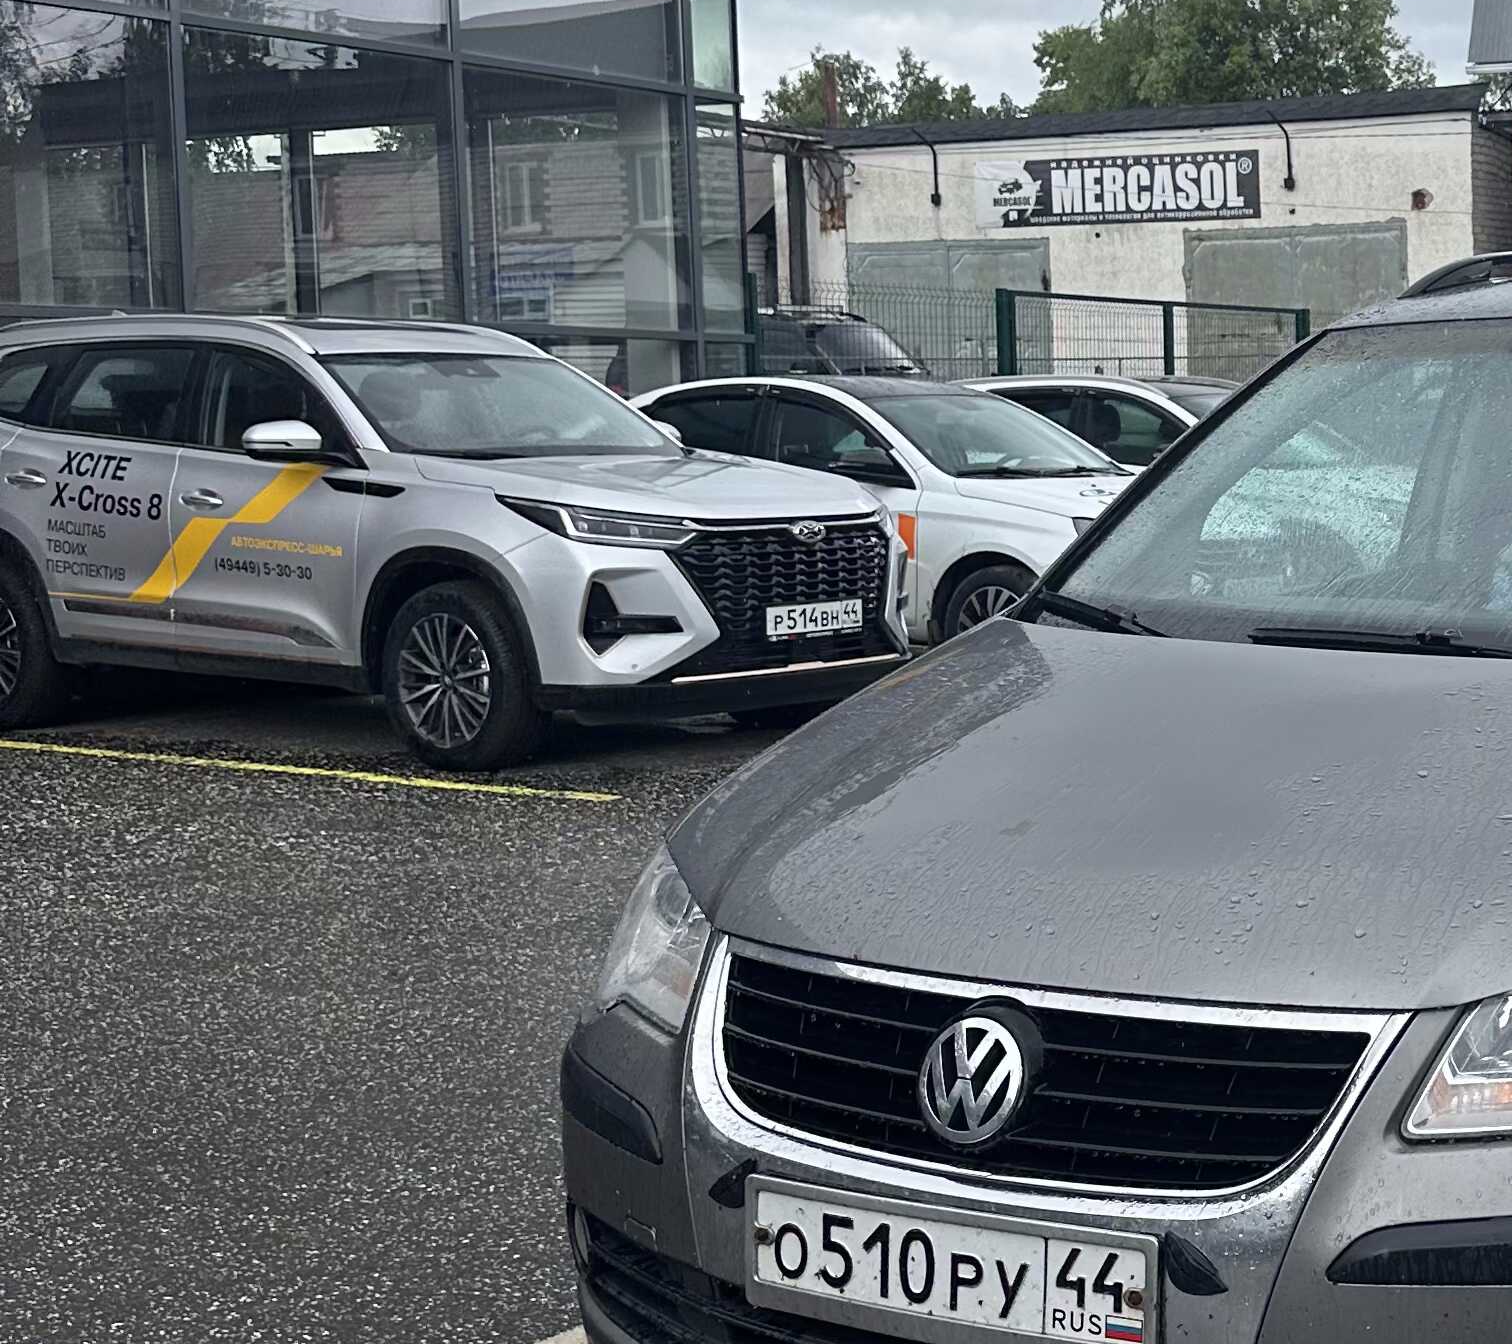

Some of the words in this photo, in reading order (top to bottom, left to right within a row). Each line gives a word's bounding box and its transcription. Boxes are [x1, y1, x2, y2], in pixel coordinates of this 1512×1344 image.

[58, 450, 132, 481] XCITE
[50, 481, 142, 518] X-Cross
[147, 493, 163, 521] 8
[47, 518, 106, 539] МАСШТАБ
[46, 537, 89, 557] ТВОИХ
[46, 558, 126, 582] ПЕРСПЕКТИВ
[263, 561, 313, 580] 5-30-30
[843, 602, 858, 619] 44
[773, 1212, 1030, 1320] О510РУ
[1055, 1247, 1125, 1315] 44
[1051, 1308, 1103, 1337] RUS
